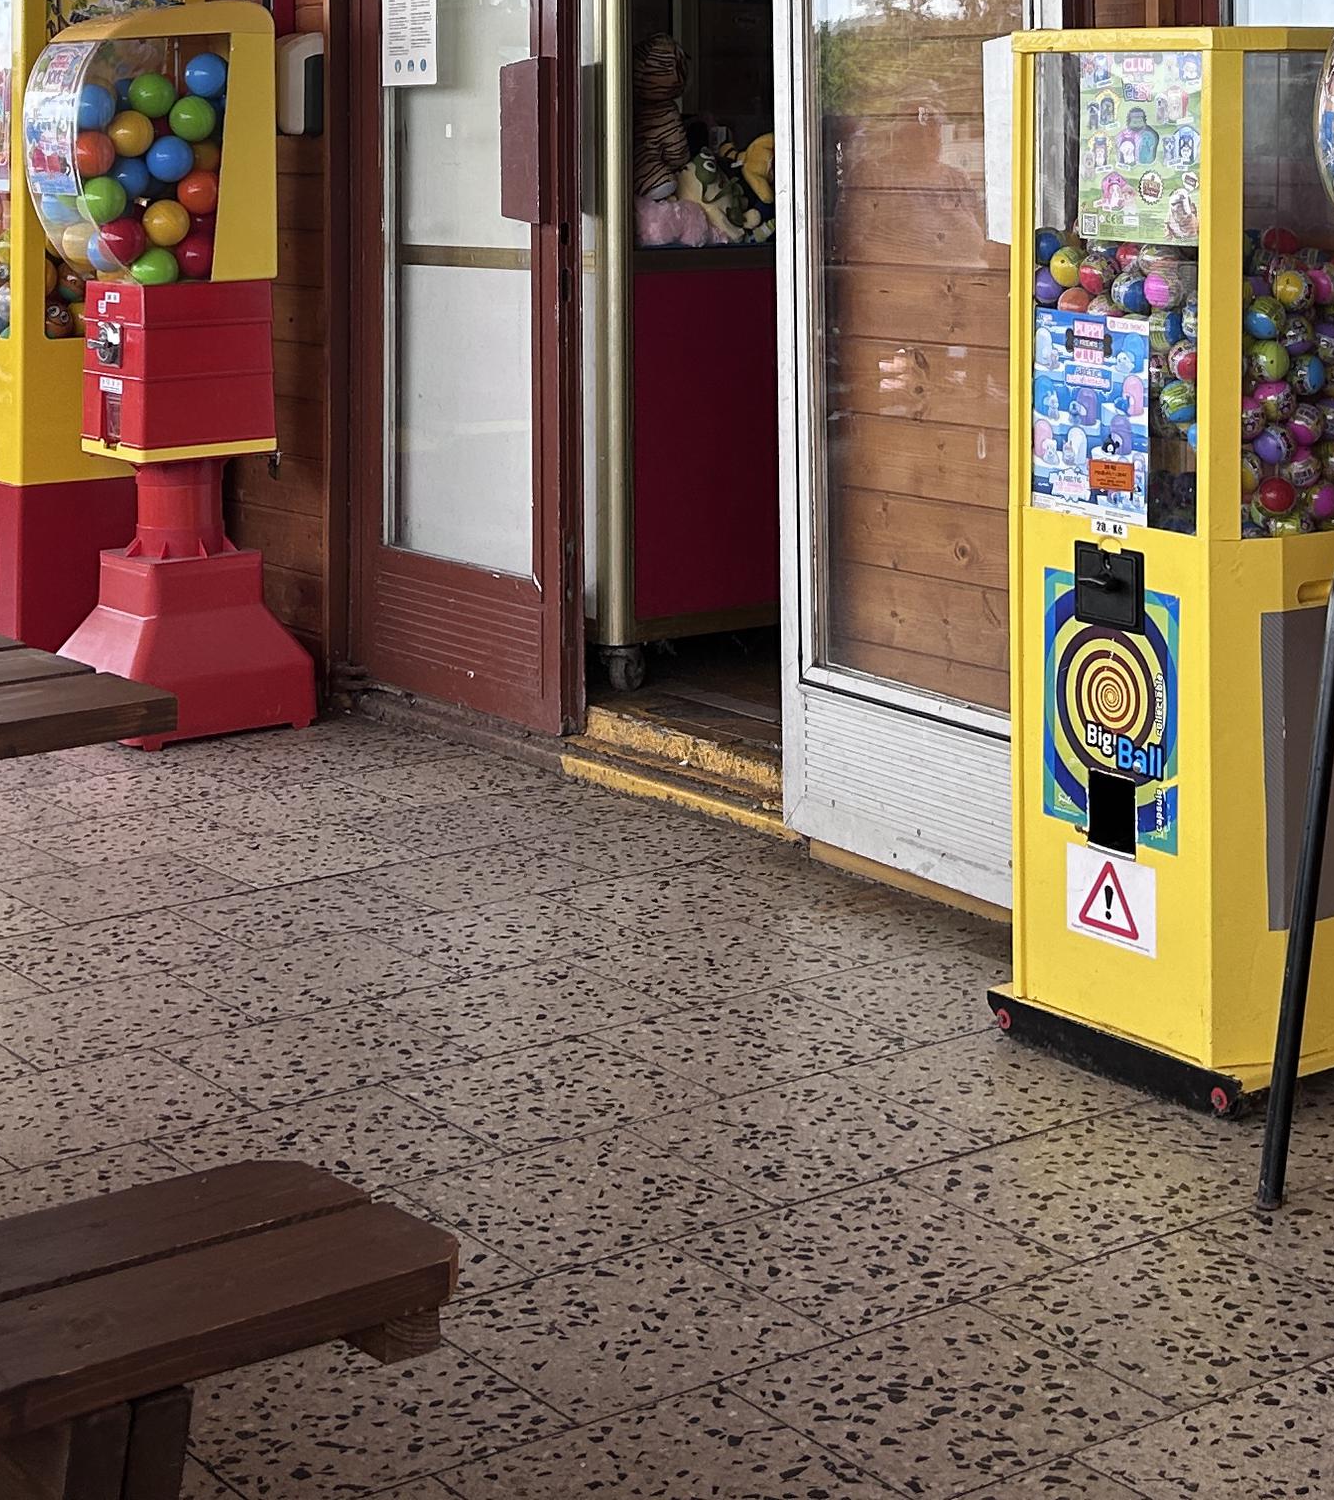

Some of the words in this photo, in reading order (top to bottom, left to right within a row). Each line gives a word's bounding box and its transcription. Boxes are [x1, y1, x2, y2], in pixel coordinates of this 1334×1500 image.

[1123, 57, 1154, 73] CLUB
[1074, 320, 1105, 340] PUPPY
[1073, 347, 1105, 365] CLUB
[1155, 673, 1164, 739] collectable
[1087, 722, 1113, 756] Big
[1117, 735, 1163, 780] Ball
[1155, 787, 1164, 834] capsule
